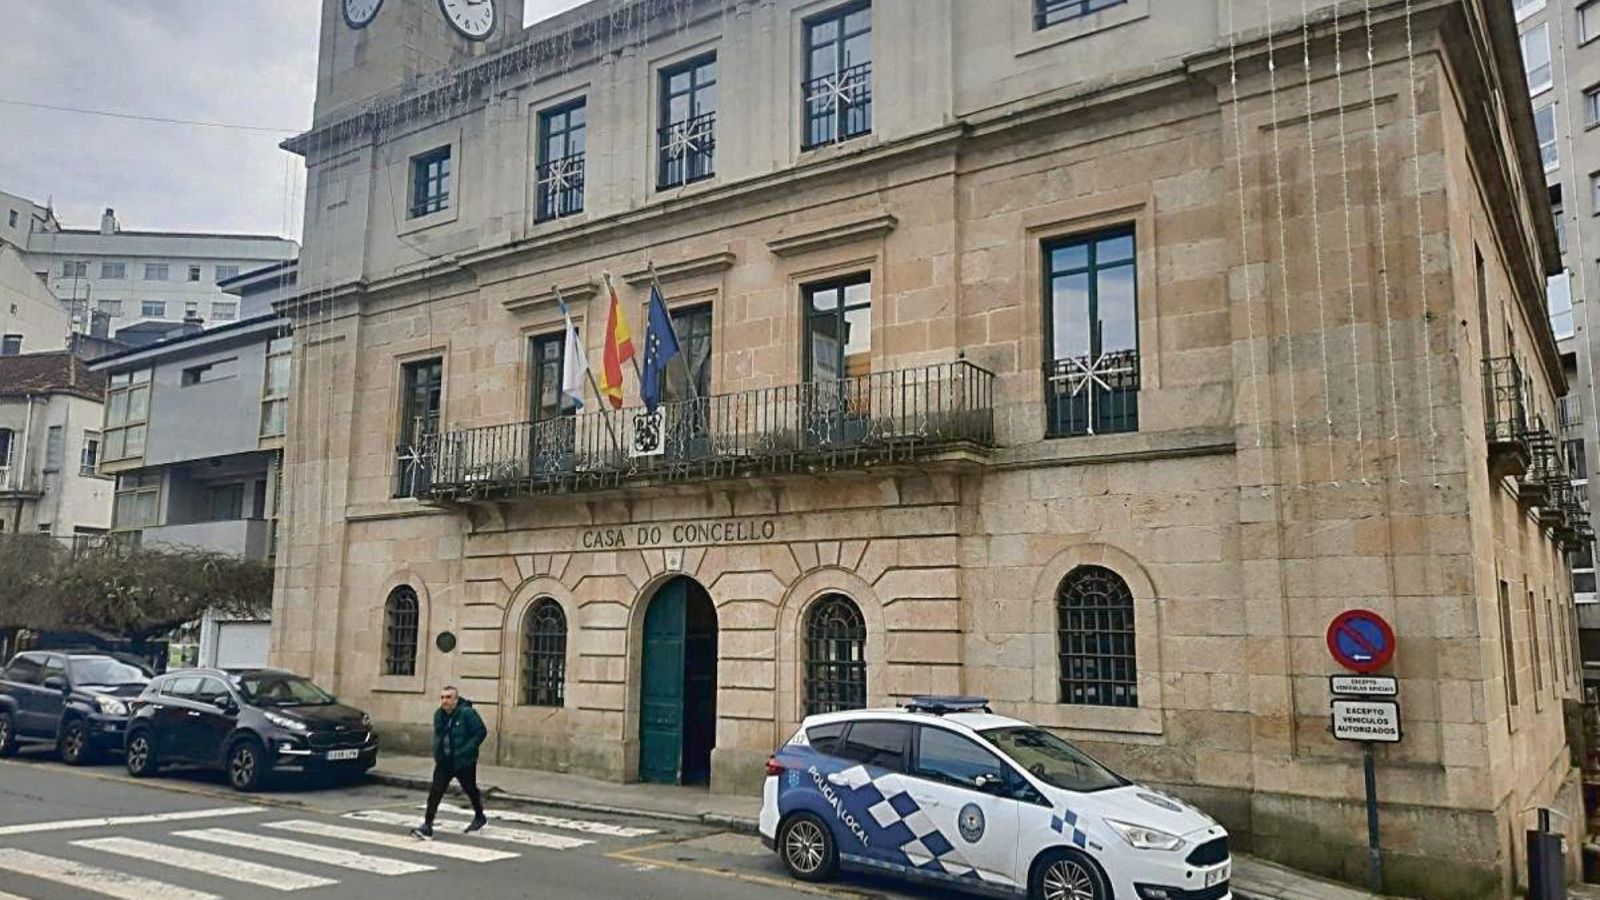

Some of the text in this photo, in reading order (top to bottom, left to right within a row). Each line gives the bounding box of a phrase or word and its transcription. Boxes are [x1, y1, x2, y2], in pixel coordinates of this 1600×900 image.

[464, 19, 470, 29] 6
[583, 520, 775, 548] CASA DO CONCELLO
[1346, 708, 1385, 716] EXCEPTO
[1343, 717, 1389, 725] VEHICULOS
[1337, 725, 1396, 735] AUTORIZADOS
[841, 809, 869, 848] LOCAL
